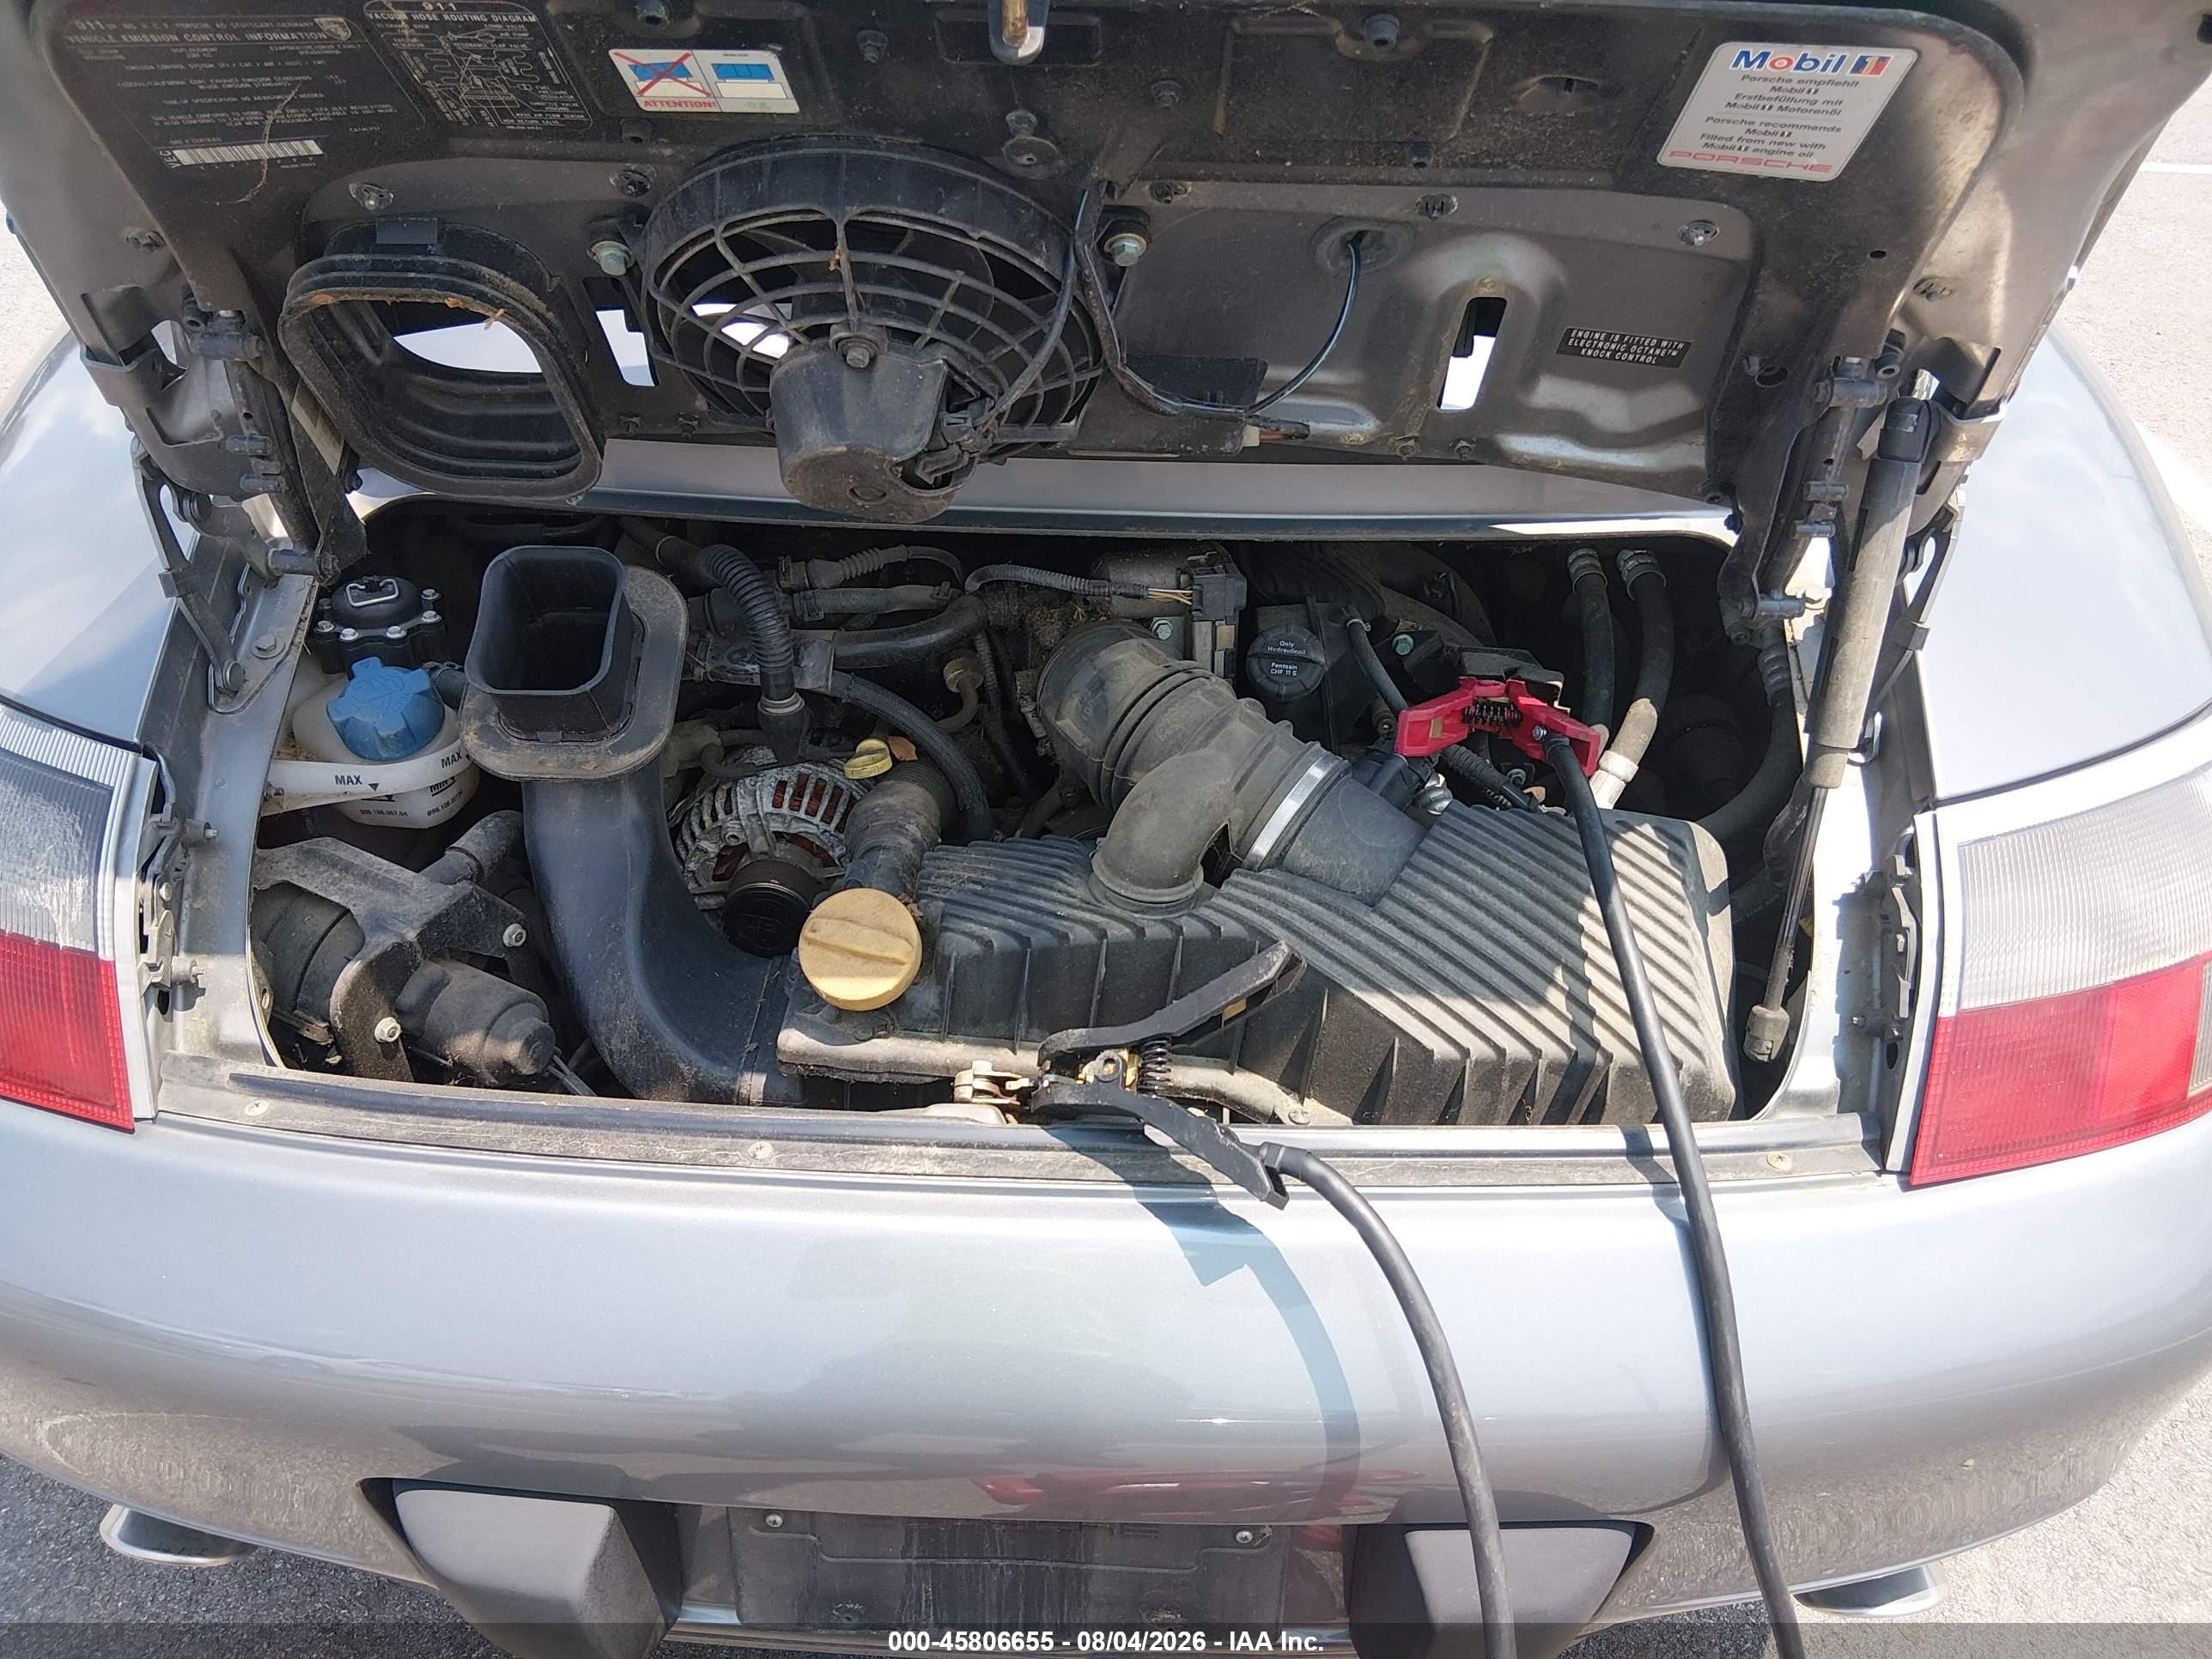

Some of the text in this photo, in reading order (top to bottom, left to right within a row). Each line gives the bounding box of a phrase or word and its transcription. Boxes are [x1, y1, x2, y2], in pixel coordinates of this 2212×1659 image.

[422, 2, 458, 10] 911
[75, 20, 106, 30] 911
[67, 34, 118, 43] VEHICLE
[245, 33, 328, 41] INFORMATION
[1731, 50, 1847, 74] Mobil
[1741, 74, 1860, 88] Porsche empfiehlt
[1770, 85, 1805, 94] Mobil
[644, 100, 717, 109] ATTENTION!
[1735, 92, 1844, 106] Erstbefüllung mit
[1725, 101, 1760, 112] Mobil
[1776, 104, 1842, 116] Motorenöl
[1705, 115, 1842, 133] Porsche recommends
[1744, 128, 1779, 137] Mobil
[1700, 132, 1827, 150] Filled from new with
[1702, 141, 1736, 152] Mobil
[1752, 147, 1791, 158] engine
[1797, 149, 1814, 158] oil
[159, 149, 182, 168] VEC
[1668, 150, 1833, 172] PORSCHE
[1568, 337, 1626, 352] ELECTRONIC
[1571, 330, 1607, 341] ENGINE
[1623, 335, 1657, 346] FITTED
[1660, 340, 1684, 349] WITH
[1580, 348, 1657, 364] KNOCK CONTROL
[441, 750, 463, 769] MAX
[335, 775, 363, 786] MAX
